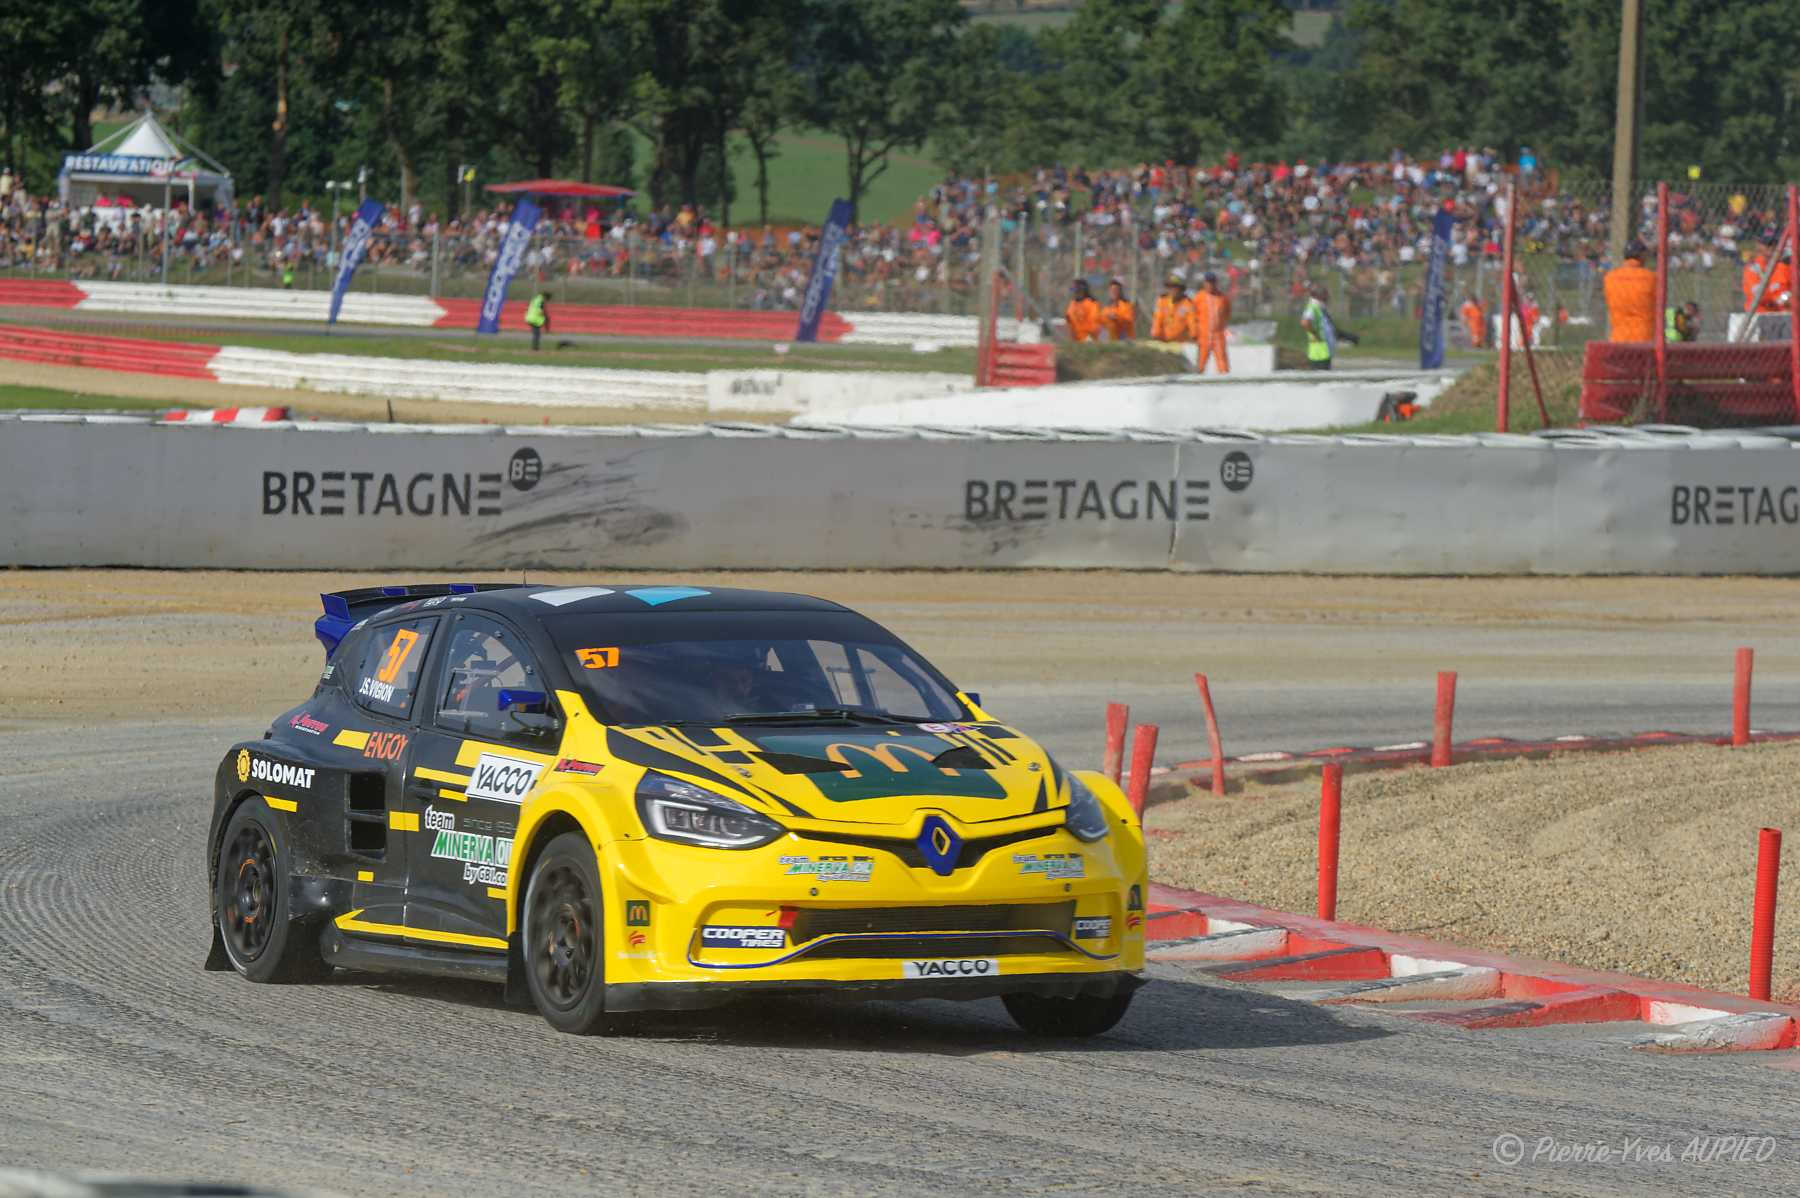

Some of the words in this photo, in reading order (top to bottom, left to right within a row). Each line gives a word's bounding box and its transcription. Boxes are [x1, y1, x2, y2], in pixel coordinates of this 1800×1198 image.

[262, 471, 503, 516] BRETAGNE
[964, 480, 1211, 521] BRETAGNE
[378, 629, 420, 684] 57
[576, 647, 620, 669] 57
[363, 731, 409, 760] ENJOY
[251, 758, 316, 789] SOLOMAT
[475, 763, 534, 797] YACCO
[425, 804, 455, 830] team
[432, 829, 496, 866] MINERVA
[702, 928, 786, 940] COOPER
[912, 959, 990, 977] YACCO
